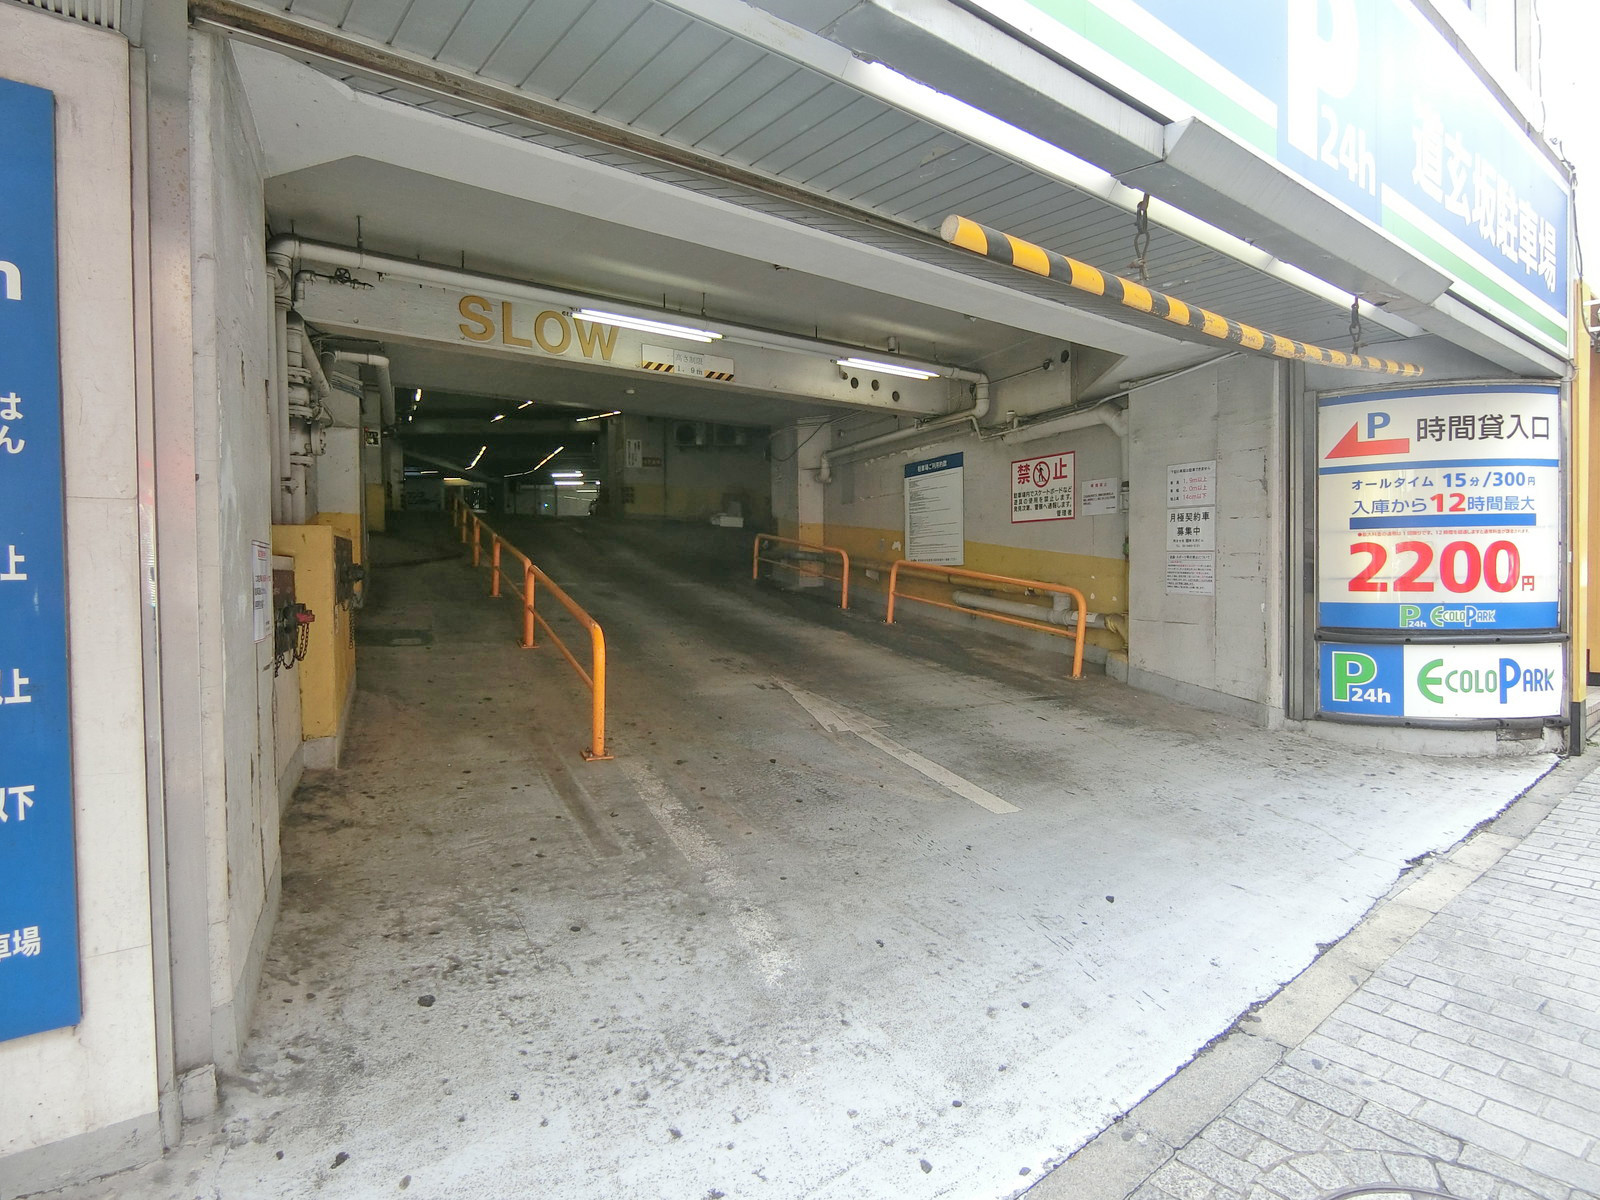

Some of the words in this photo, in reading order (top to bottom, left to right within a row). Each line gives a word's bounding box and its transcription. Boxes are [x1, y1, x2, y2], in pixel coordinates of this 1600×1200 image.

[1320, 103, 1376, 197] 24h
[1412, 102, 1556, 293] 道玄坂駐車場
[458, 294, 620, 361] SLOW
[1366, 412, 1391, 439] P
[1416, 414, 1550, 443] 時間貸入口
[1017, 463, 1031, 485] 禁
[1052, 457, 1068, 480] 止
[1351, 476, 1434, 491] オールタイム
[1170, 511, 1210, 522] 月極契約車
[1351, 492, 1535, 515] 入庫から12時間最大
[1176, 526, 1201, 537] 募集中
[1348, 540, 1535, 594] 2200円
[0, 668, 32, 704] 上
[1331, 650, 1378, 702] P
[1351, 687, 1391, 703] 24h
